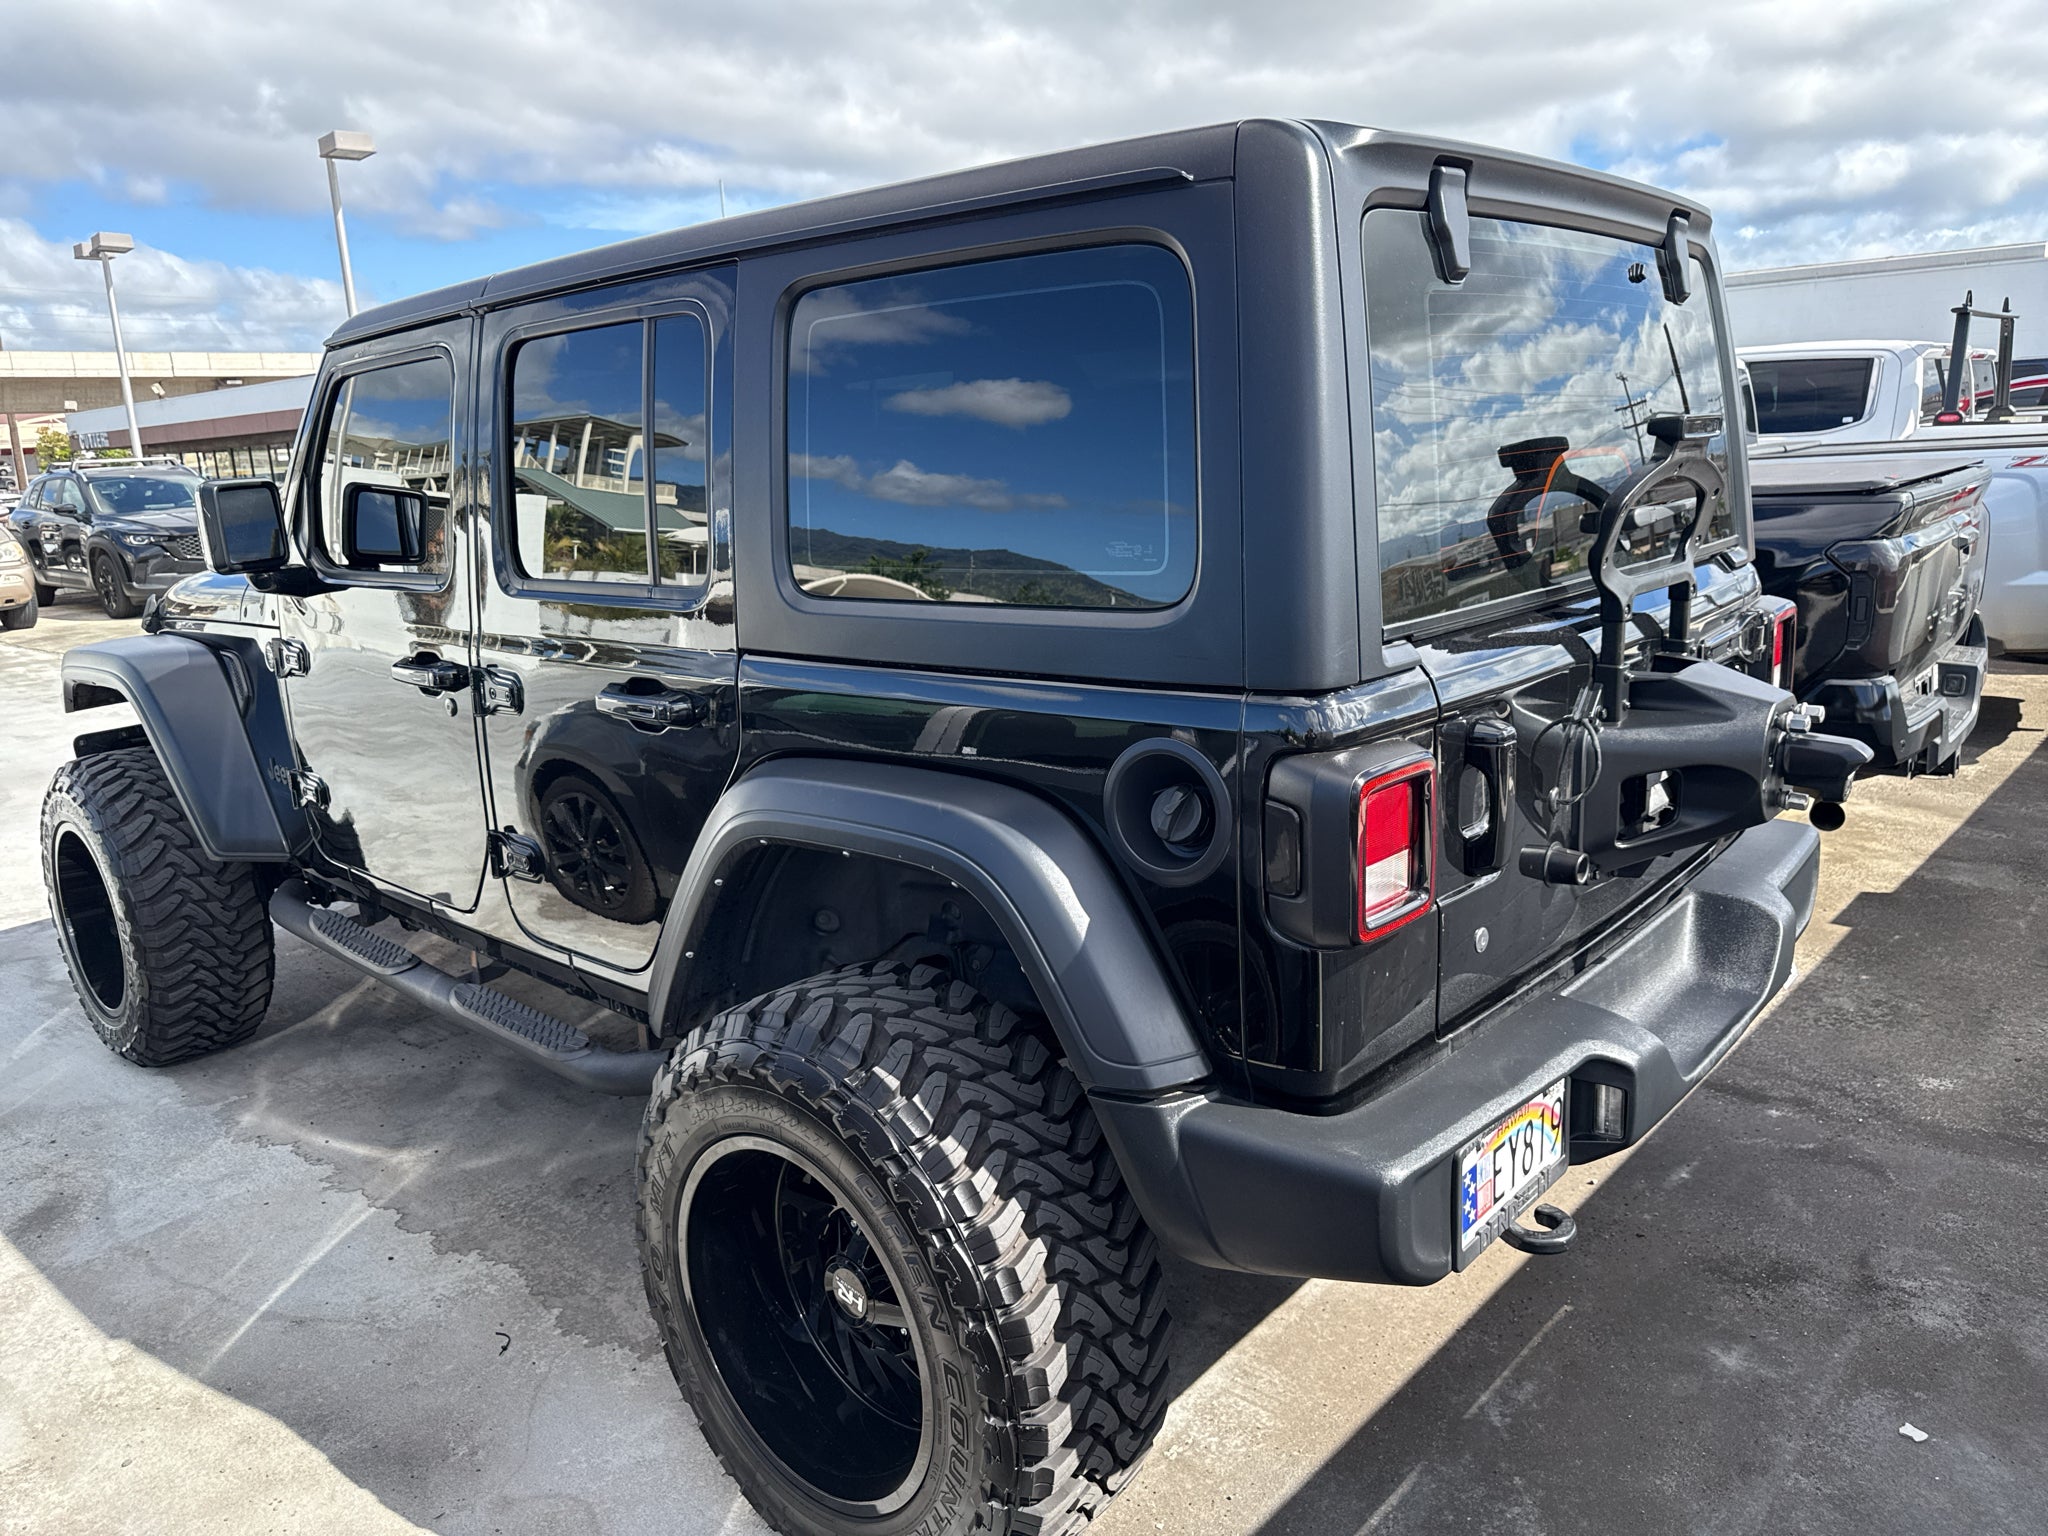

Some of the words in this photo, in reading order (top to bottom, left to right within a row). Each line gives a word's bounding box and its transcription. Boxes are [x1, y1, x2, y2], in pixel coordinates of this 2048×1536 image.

[2005, 455, 2048, 469] Z
[267, 757, 290, 785] Jee
[1496, 1103, 1530, 1138] HAWAII
[1493, 1097, 1563, 1205] EY819
[853, 1173, 949, 1334] OPEN
